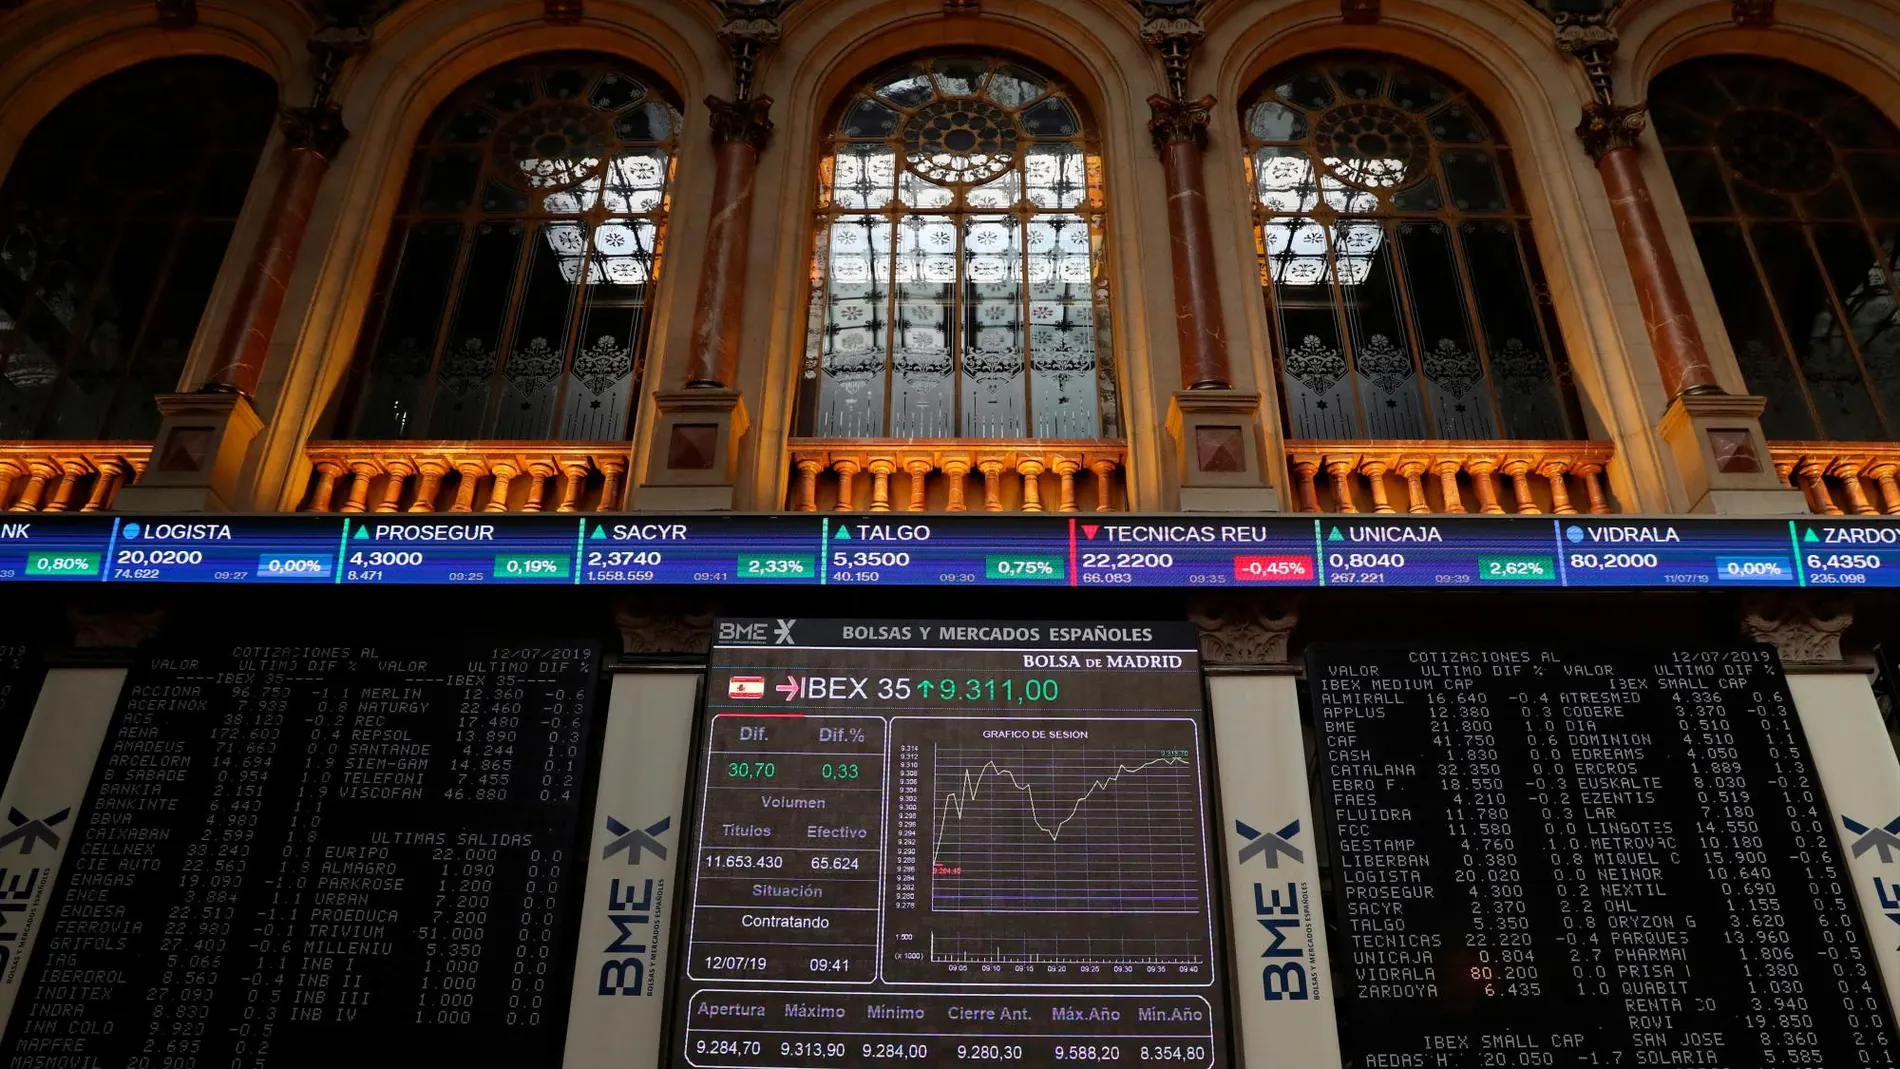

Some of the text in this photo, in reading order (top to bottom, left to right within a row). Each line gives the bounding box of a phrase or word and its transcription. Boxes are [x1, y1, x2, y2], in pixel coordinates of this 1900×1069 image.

[1, 523, 30, 539] NK
[144, 524, 231, 540] LOGISTA
[375, 525, 494, 541] PROSEGUR
[612, 525, 687, 540] SACYR
[856, 525, 931, 541] TALGO
[1103, 526, 1267, 542] TECNICAS REU
[1349, 526, 1443, 542] UNICAJA
[1587, 527, 1680, 542] VIDRALA
[1823, 528, 1900, 543] ZARDO
[37, 557, 89, 571] 0,80%
[117, 550, 202, 566] 20,0200
[349, 551, 423, 568] 4,3000
[588, 551, 661, 568] 2,3740
[833, 552, 910, 569] 5,3500
[1082, 553, 1173, 570] 22,2200
[1329, 553, 1405, 570] 0,8040
[1570, 553, 1658, 570] 80,2000
[1807, 554, 1880, 571] 6,4350
[114, 568, 159, 579] 74.622
[268, 560, 321, 573] 0,00%
[506, 560, 557, 573] 0,19%
[748, 560, 804, 573] 2,33%
[998, 561, 1053, 574] 0,75%
[1242, 562, 1305, 575] -0,45%
[1490, 562, 1544, 575] 2,62%
[1727, 562, 1782, 576] 0,00%
[214, 571, 248, 580] 09:27
[348, 570, 382, 580] 8.471
[449, 572, 484, 581] 09:25
[587, 571, 654, 581] 1.558.559
[693, 572, 727, 581] 09:41
[833, 571, 879, 581] 40.150
[939, 573, 975, 582] 09:30
[1083, 573, 1132, 583] 66.083
[1189, 574, 1226, 583] 09:35
[1331, 573, 1384, 583] 267.221
[1435, 574, 1470, 583] 09:39
[1664, 574, 1709, 583] 11/07/19
[1811, 573, 1865, 583] 235.098
[843, 626, 912, 640] BOLSAS
[920, 627, 931, 640] Y
[939, 627, 1040, 641] MERCADOS
[1050, 625, 1153, 642] ESPAÑOLES
[1023, 655, 1182, 669] BOLSA DE MADRID
[1408, 651, 1770, 663] COTIZACIONES AL 12/07/2019
[1328, 664, 1753, 677] VALOR ULTIMO DIF VALOR ULTIMO DIF
[800, 676, 1059, 705] IBEX 35 9.311,00
[1321, 679, 1473, 691] IBEX MEDIUM CAP
[1659, 677, 1747, 690] SMALL CAP
[1321, 692, 1487, 705] ALMIRALL 16.640
[1324, 706, 1490, 719] APPLUS 12.380
[1563, 706, 1625, 718] CODERE
[739, 726, 769, 741] Dif.
[1325, 720, 1493, 733] BME 21.800
[983, 730, 1030, 739] GRAFICO
[1032, 730, 1046, 739] DE
[1327, 734, 1496, 747] CAF 41.750
[1569, 733, 1734, 746] DOMINION 4.510
[728, 762, 859, 780] 30,70 0,33
[1331, 763, 1500, 776] CATALANA 32.350
[1575, 763, 1638, 775] ERCROS
[761, 796, 826, 809] Volumen
[1336, 807, 1509, 821] FLUIDRA 11.780
[722, 823, 867, 838] Títulos Efectivo
[1340, 839, 1415, 851] GESTAMP
[706, 855, 859, 870] 11.653.430 65.624
[1597, 866, 1772, 880] NEINOR 10.640
[752, 884, 822, 898] Situación
[1346, 885, 1523, 899] PROSEGUR 4.300
[742, 915, 829, 929] Contratando
[646, 879, 664, 997] BOLSAS MERCADOS ESPAÑOLES
[1300, 882, 1320, 1000] BOLSAS MERCADOS ESPAÑOLES
[1352, 933, 1532, 948] TECNICAS 22.220
[705, 956, 849, 972] 12/07/19 09:41
[1355, 966, 1538, 981] VIDRALA 80.200
[1357, 983, 1542, 998] ZARDOYA 6.435
[1622, 982, 1688, 995] QUABIT
[697, 1002, 1203, 1021] Apertura Máximo Mínimo Cierre Ant. Máx.Año Mín.Año
[1423, 1033, 1585, 1050] IBEX SMALL CAP
[696, 1040, 1205, 1062] 9.284,70 9.313,90 9.284,00 9.280,30 9.588,20 8.354,80
